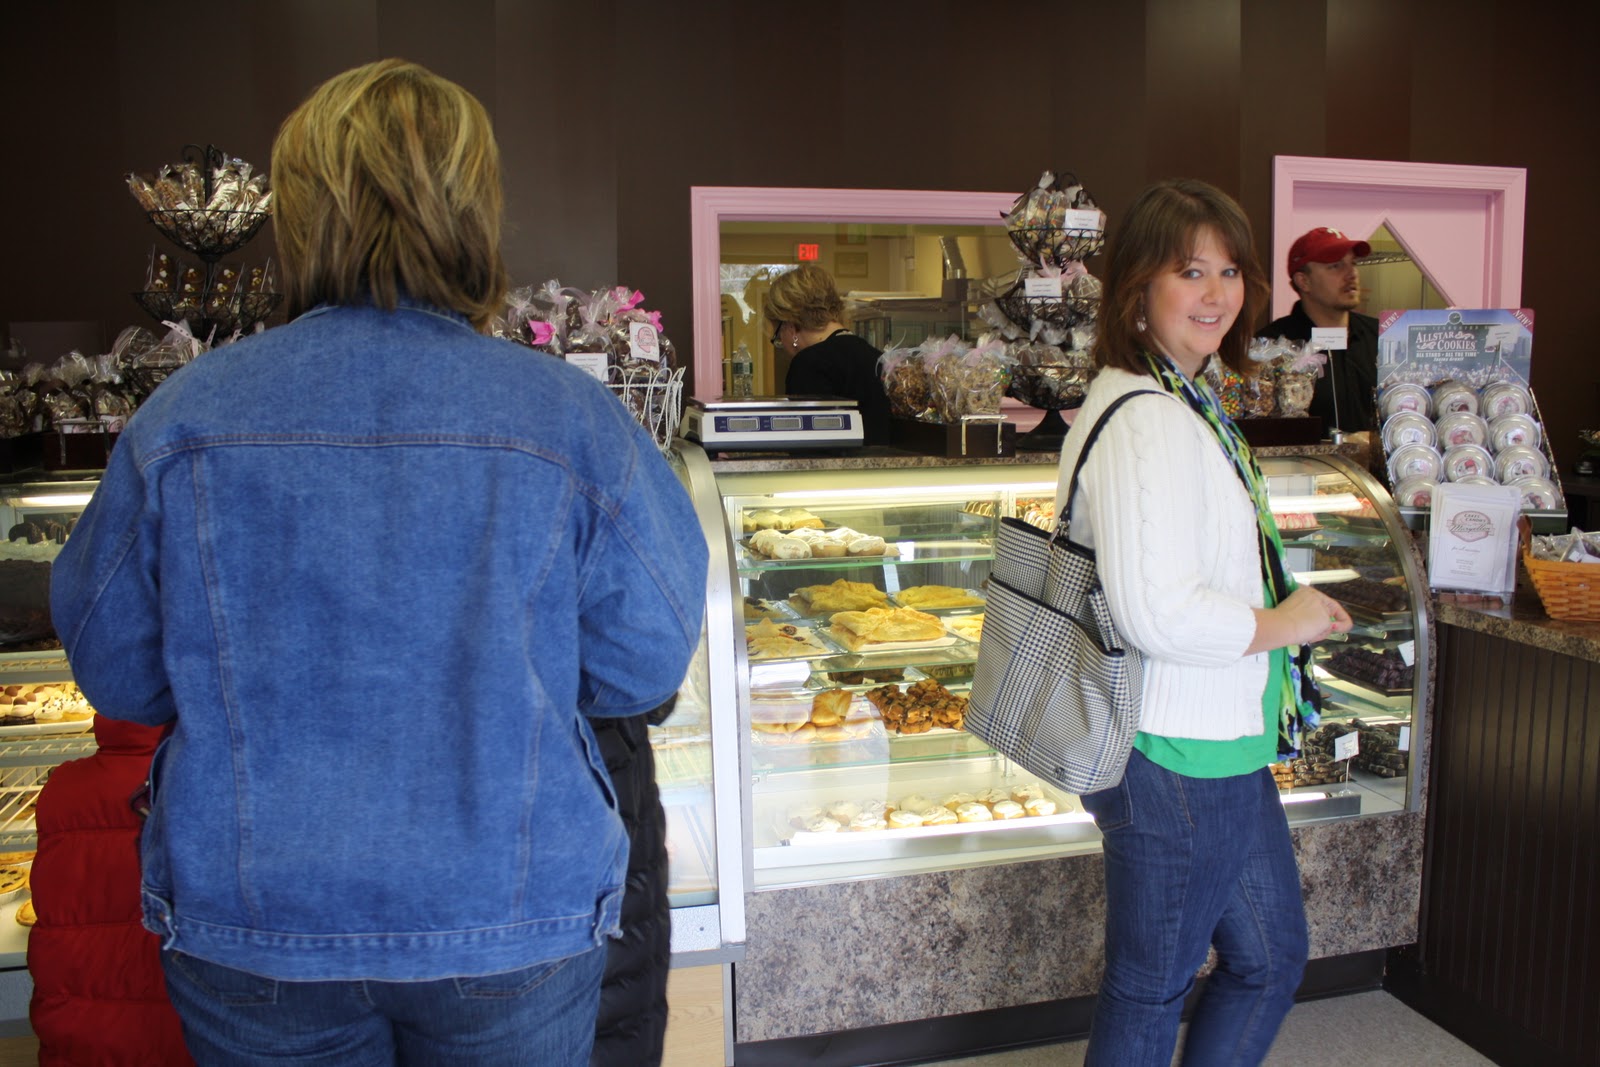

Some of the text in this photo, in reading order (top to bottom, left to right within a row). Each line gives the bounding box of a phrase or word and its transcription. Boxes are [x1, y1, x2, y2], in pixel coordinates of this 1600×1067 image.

[798, 243, 819, 260] EXIT
[1380, 312, 1400, 331] NEW!
[1513, 310, 1532, 327] NEW!
[1416, 331, 1454, 343] ALLSTAR
[1437, 340, 1476, 350] COOKIES
